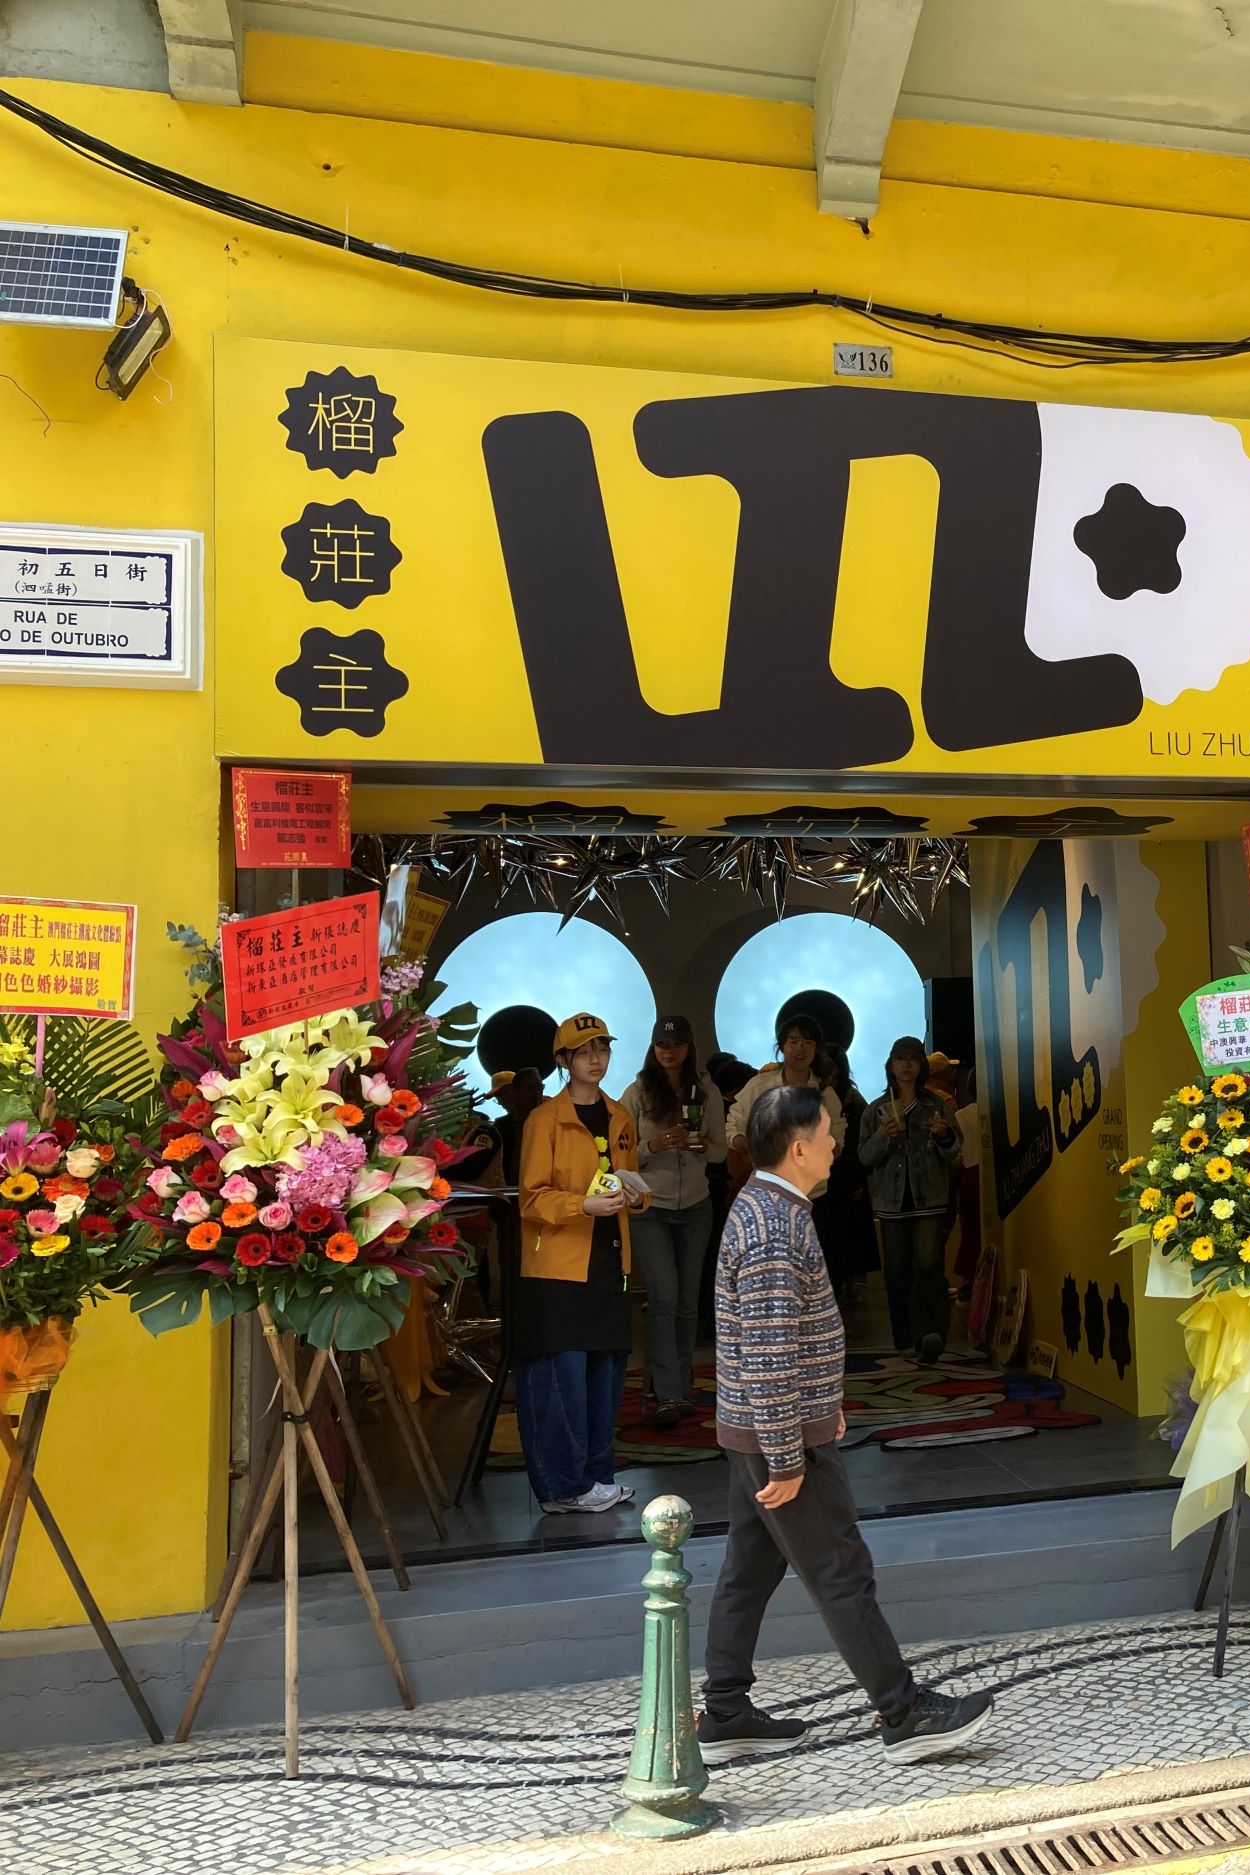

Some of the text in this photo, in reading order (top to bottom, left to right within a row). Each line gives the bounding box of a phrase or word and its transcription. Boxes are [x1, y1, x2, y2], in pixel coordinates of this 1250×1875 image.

[858, 351, 889, 373] 136
[307, 392, 376, 713] 榴莊主
[17, 558, 148, 582] 初五日街
[14, 610, 78, 626] RUA DE
[21, 630, 42, 643] DE
[51, 631, 129, 647] OUTUBRO
[1149, 731, 1192, 756] LIU
[275, 780, 314, 796] 榴莊主
[247, 925, 304, 958] 榴莊主
[49, 948, 101, 971] 大展鴻圖
[0, 972, 99, 997] 色色婚紗攝影
[1102, 1108, 1123, 1126] GRAND
[1098, 1133, 1124, 1151] OPENING
